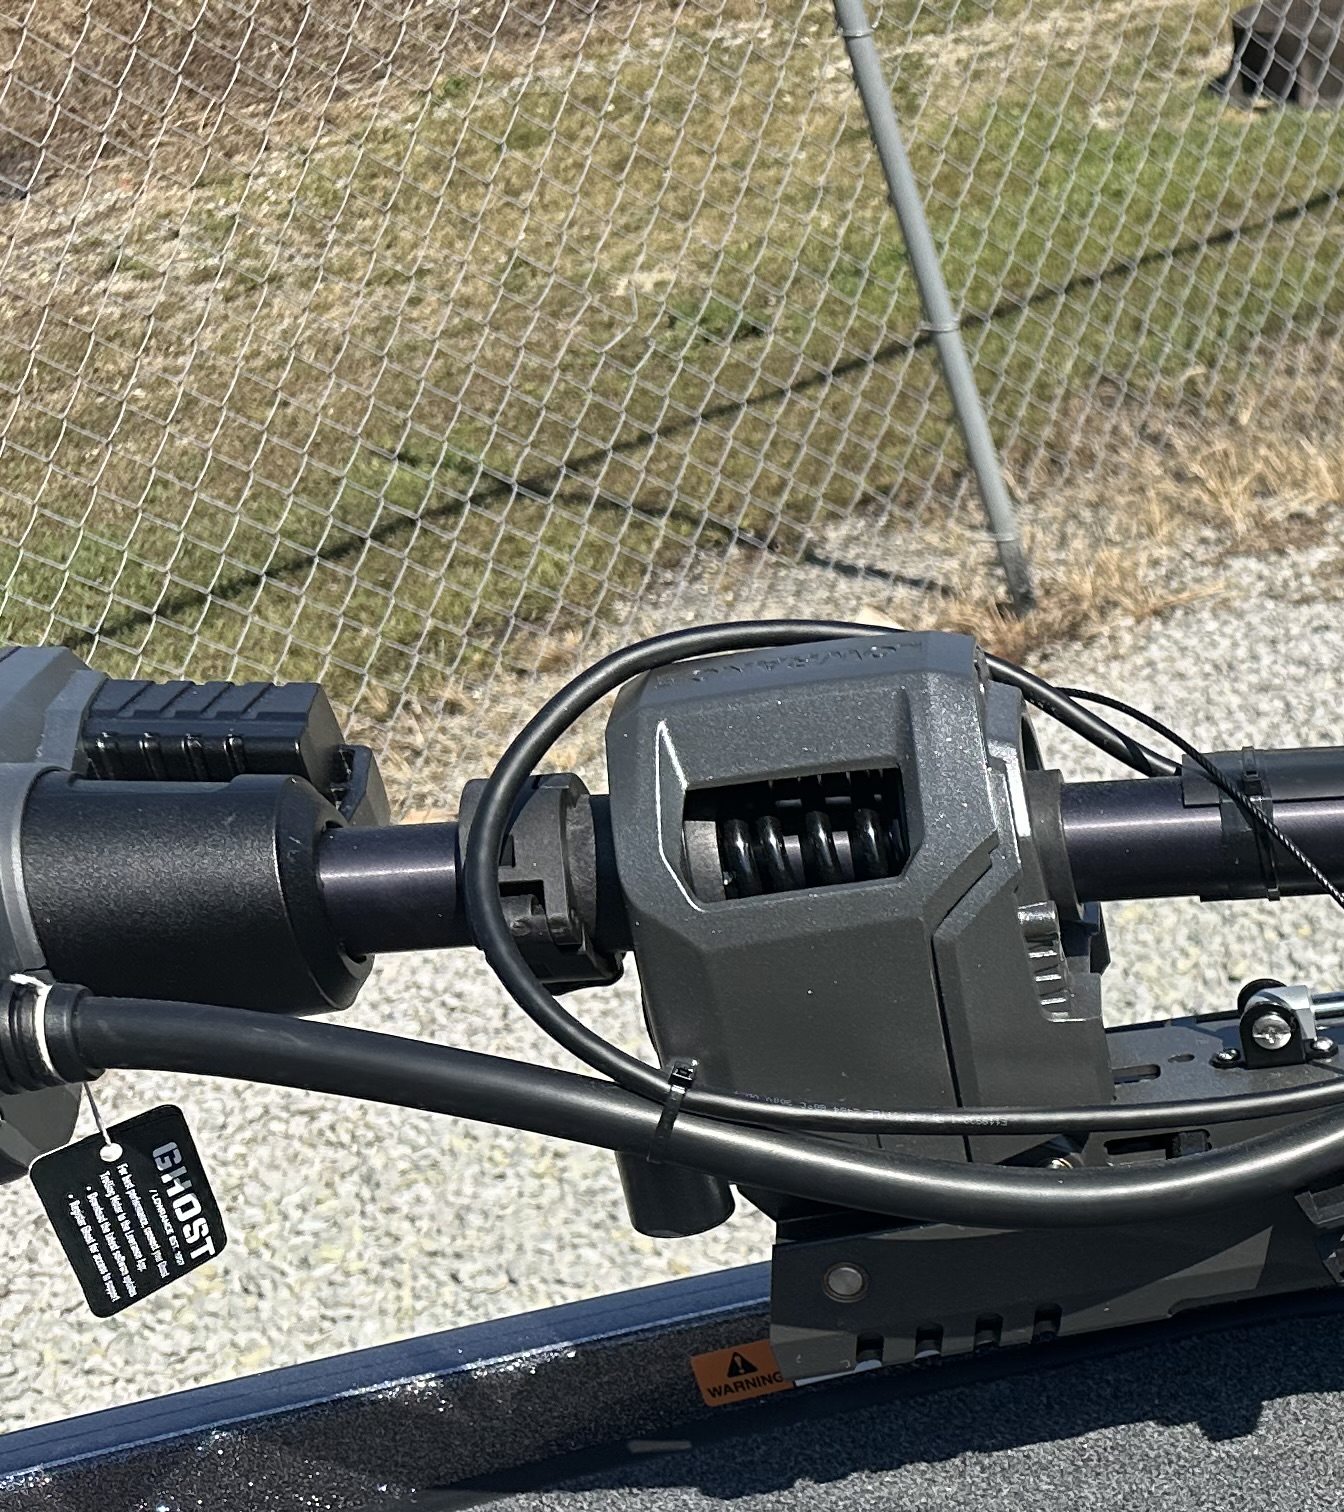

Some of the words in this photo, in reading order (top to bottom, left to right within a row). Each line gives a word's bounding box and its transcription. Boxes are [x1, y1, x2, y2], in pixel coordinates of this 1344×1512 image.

[116, 1163, 128, 1176] For
[99, 1170, 115, 1197] Trolling
[121, 1174, 135, 1190] best
[87, 1191, 108, 1223] Download
[109, 1194, 123, 1214] Motor
[152, 1141, 216, 1260] GHOST
[69, 1199, 87, 1226] Register
[117, 1212, 126, 1221] to
[151, 1193, 174, 1235] LOWRANCE
[80, 1225, 96, 1245] Ghost
[100, 1221, 111, 1234] the
[120, 1219, 131, 1232] the
[88, 1242, 99, 1253] for
[104, 1231, 120, 1252] latest
[124, 1229, 143, 1259] Lowrance
[112, 1250, 129, 1276] software
[102, 1272, 111, 1281] to
[122, 1274, 137, 1297] updates
[104, 1280, 120, 1302] support
[707, 1371, 784, 1398] WARNING
